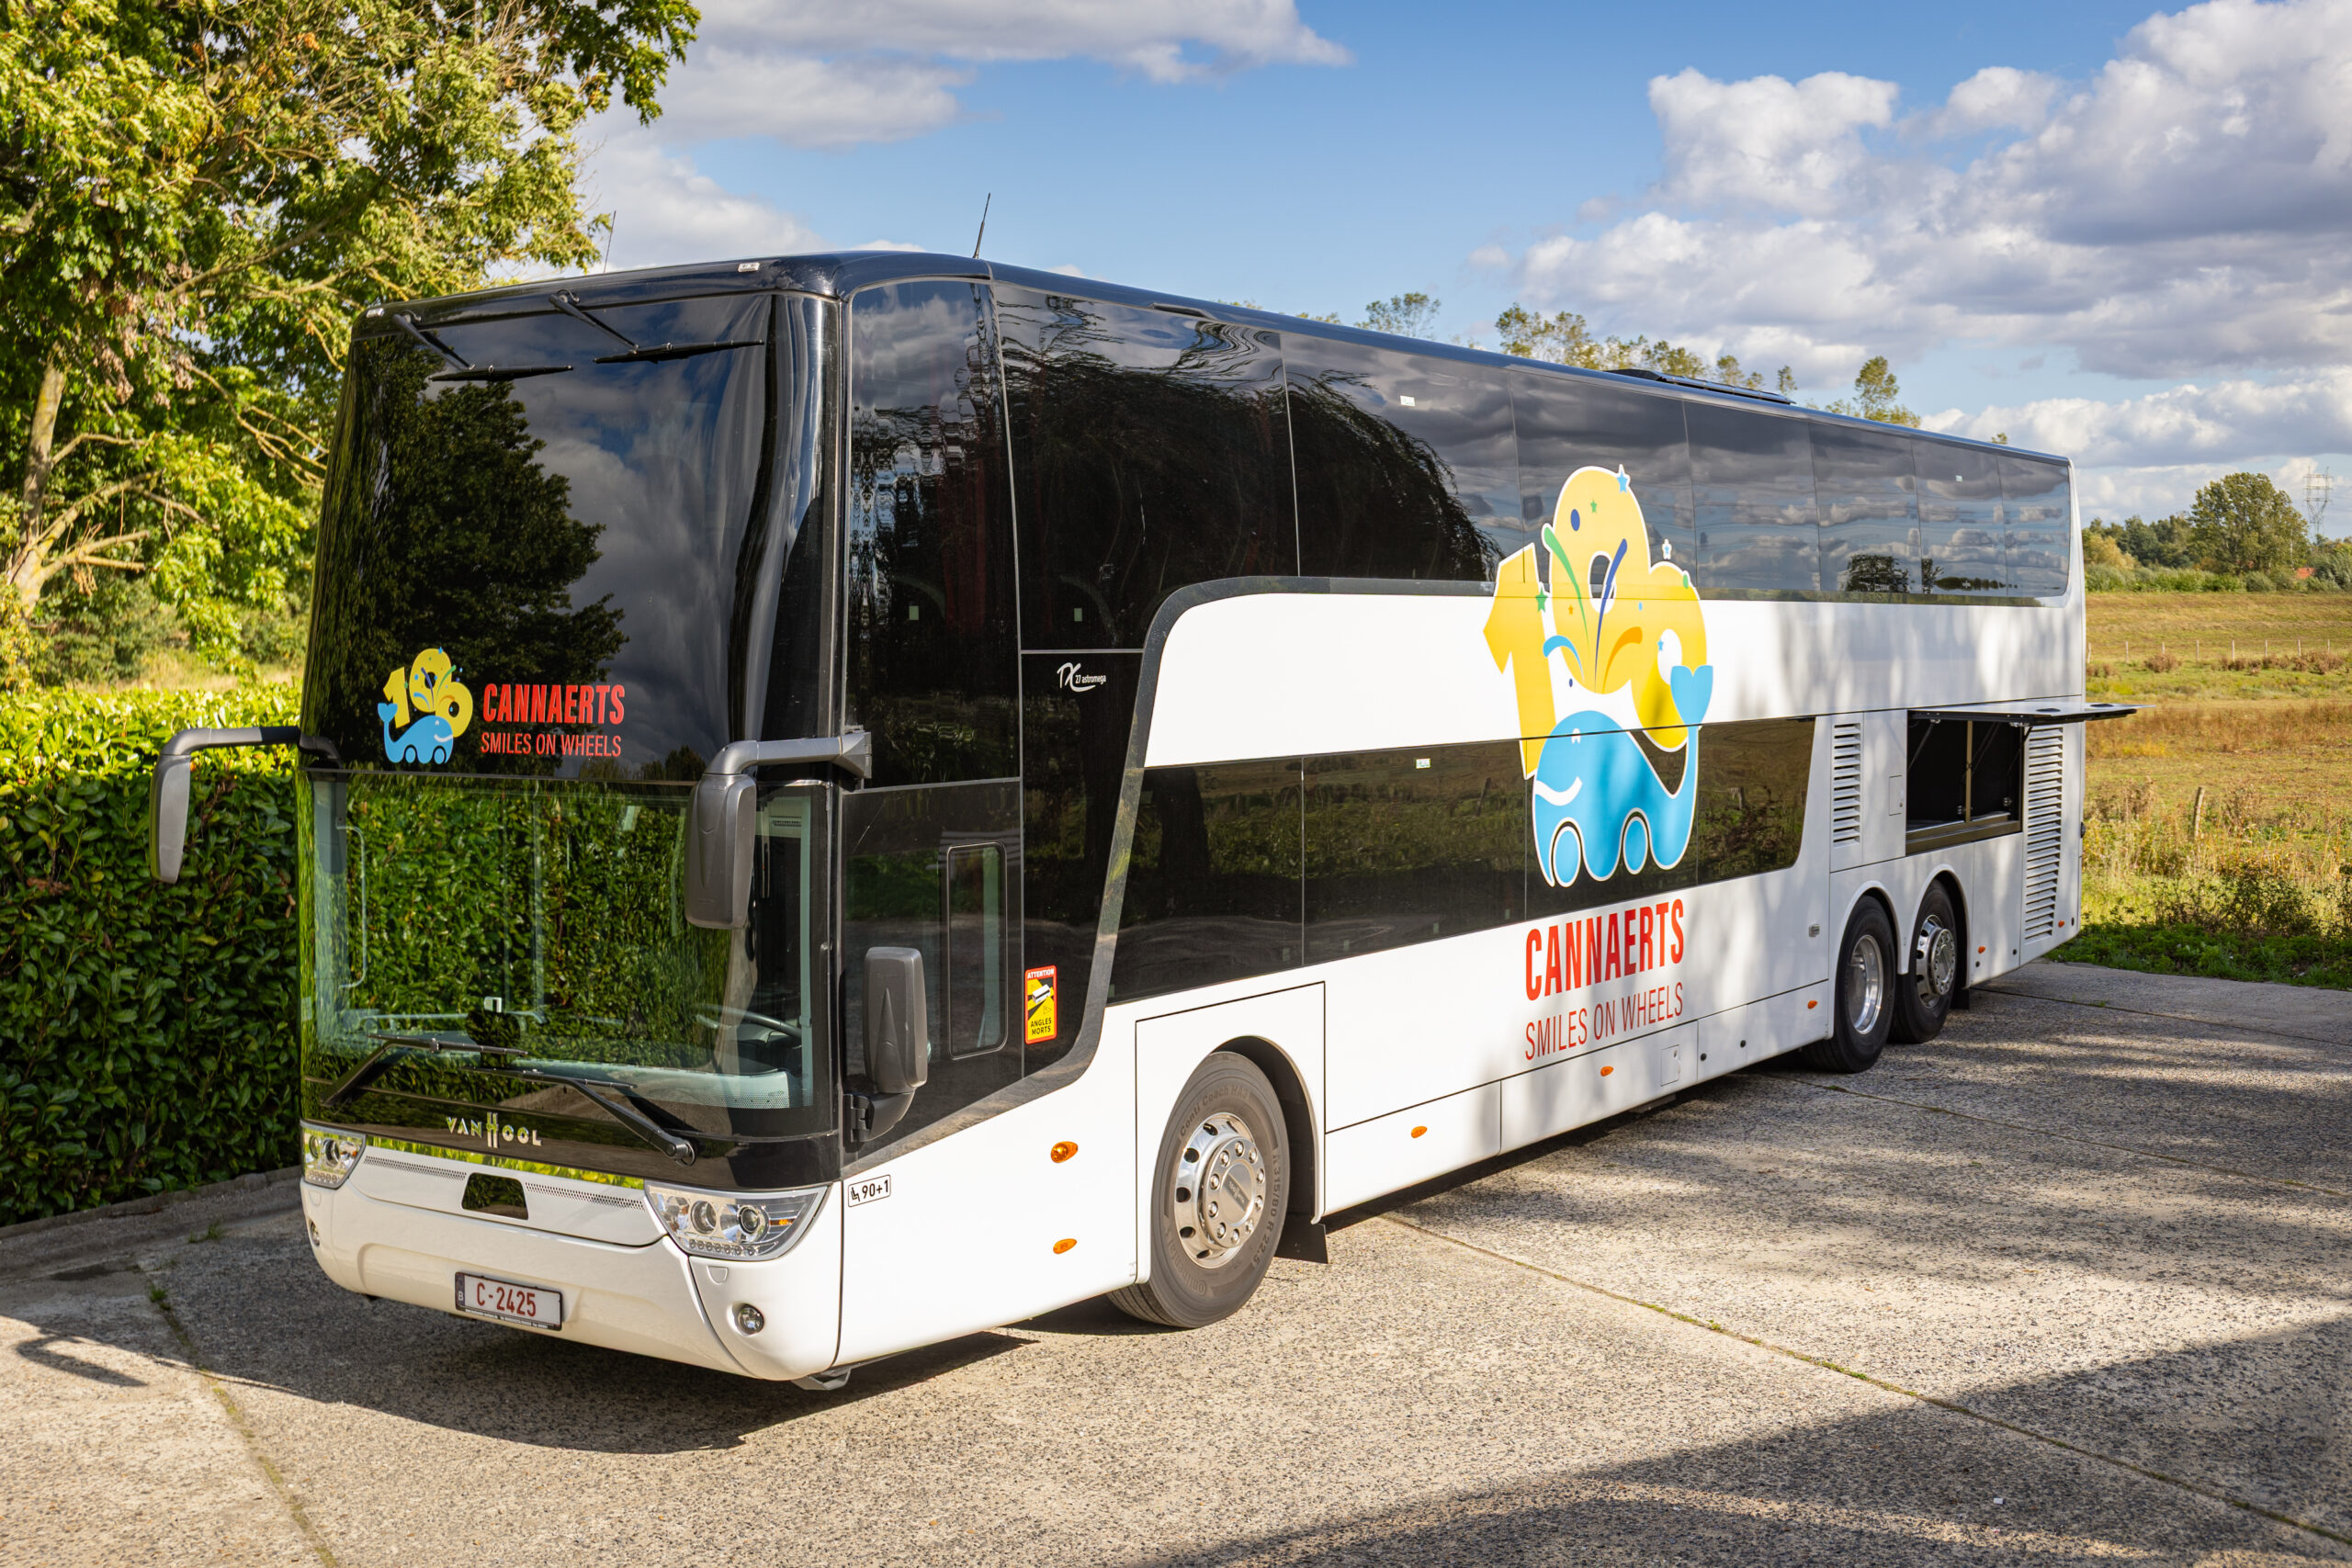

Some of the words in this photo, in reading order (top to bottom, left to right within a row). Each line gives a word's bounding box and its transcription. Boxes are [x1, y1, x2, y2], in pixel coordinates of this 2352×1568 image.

[1082, 674, 1106, 685] astromega
[482, 683, 626, 725] CANNAERTS
[481, 732, 532, 755] SMILES
[537, 733, 556, 755] ON
[560, 735, 622, 757] WHEELS
[1525, 898, 1684, 1001] CANNAERTS
[1027, 968, 1055, 979] ATTENTION
[1030, 1017, 1052, 1028] ANGLES
[1032, 1025, 1051, 1036] MORTS
[1525, 1008, 1588, 1061] SMILES
[1593, 999, 1616, 1041] ON
[1622, 981, 1683, 1032] WHEELS
[458, 1291, 465, 1302] B
[477, 1282, 537, 1317] C-2425
